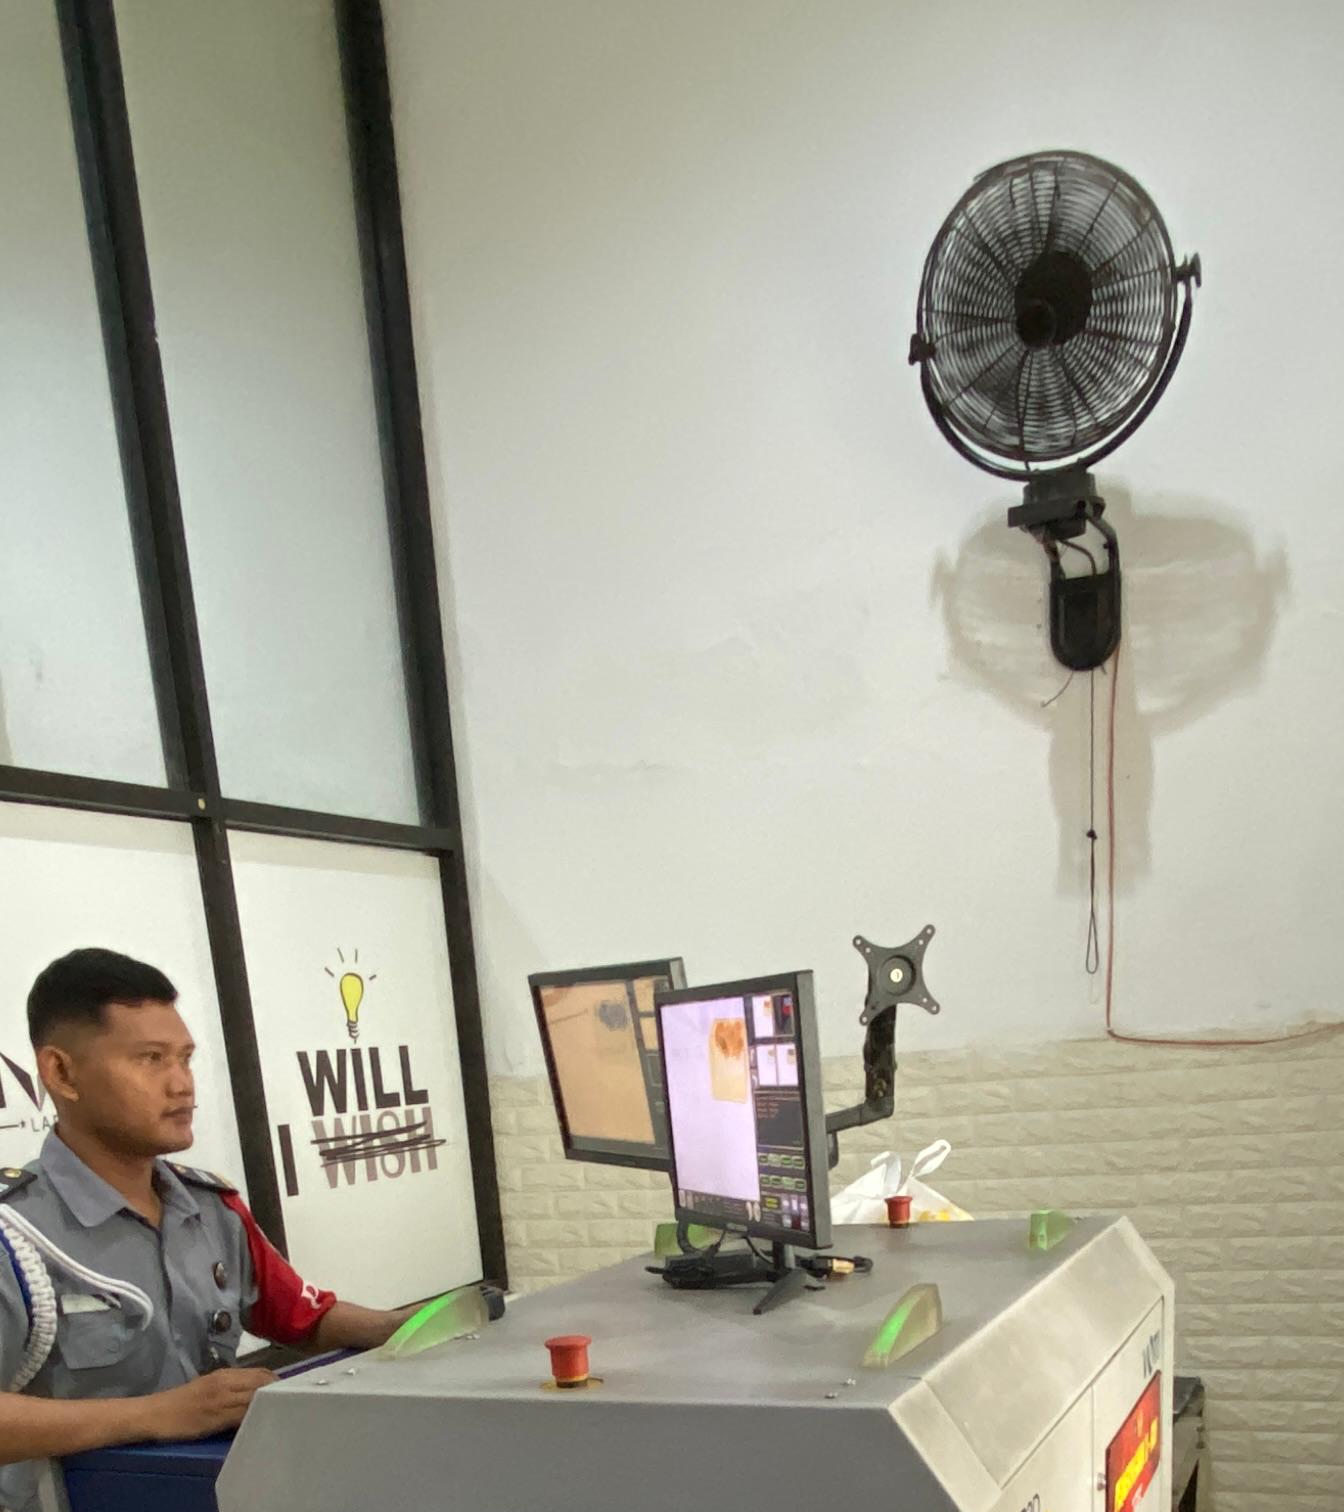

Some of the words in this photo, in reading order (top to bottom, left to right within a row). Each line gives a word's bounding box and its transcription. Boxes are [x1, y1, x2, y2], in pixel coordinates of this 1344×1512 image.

[296, 1044, 430, 1117] WILL
[276, 1123, 300, 1198] I
[311, 1106, 439, 1190] WISH
